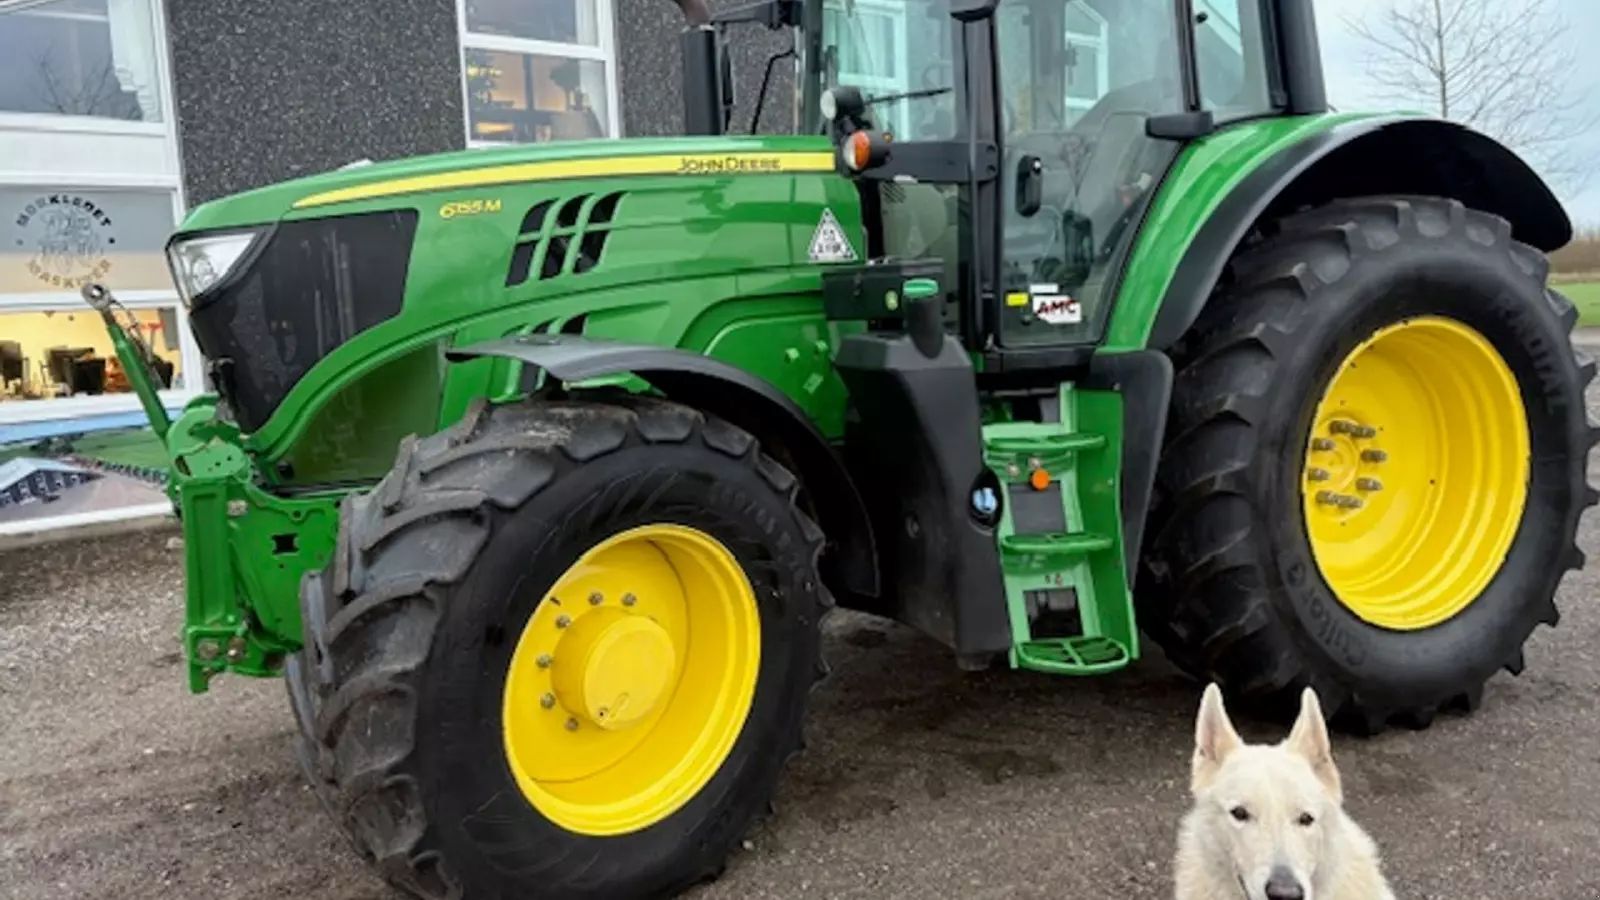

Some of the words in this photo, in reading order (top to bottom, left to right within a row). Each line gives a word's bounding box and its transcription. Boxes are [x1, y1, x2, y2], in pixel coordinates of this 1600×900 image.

[677, 157, 723, 172] JOHN
[725, 157, 781, 170] DEERE
[1037, 301, 1078, 314] AMC
